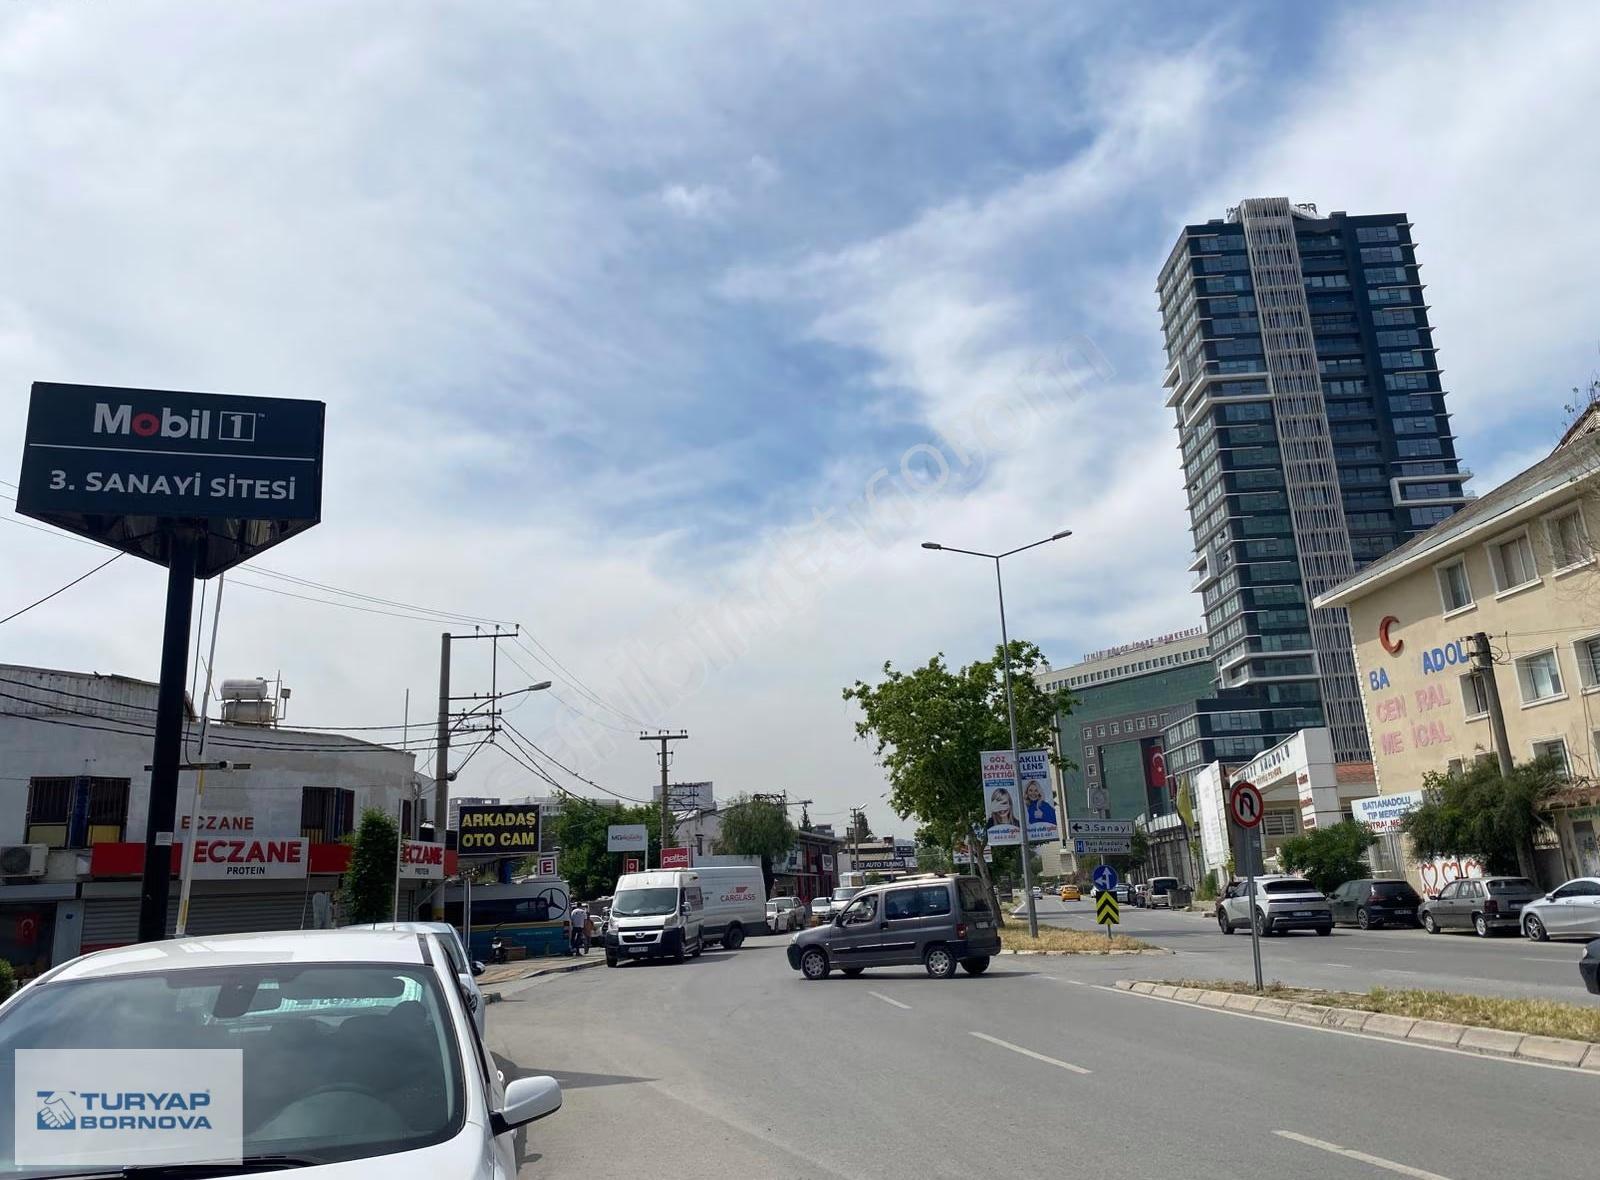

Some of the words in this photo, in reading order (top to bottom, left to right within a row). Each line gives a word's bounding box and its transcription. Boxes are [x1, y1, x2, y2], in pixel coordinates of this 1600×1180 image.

[92, 402, 211, 440] Mobil
[50, 469, 76, 491] 3.
[86, 471, 201, 497] SANAYİ
[210, 472, 296, 500] SİTESİ
[1415, 683, 1452, 712] RAL
[1022, 762, 1044, 771] LENS
[461, 812, 536, 828] ARKADAŞ
[462, 833, 496, 847] OTO
[500, 832, 535, 846] CAM
[193, 840, 302, 864] ECZANE
